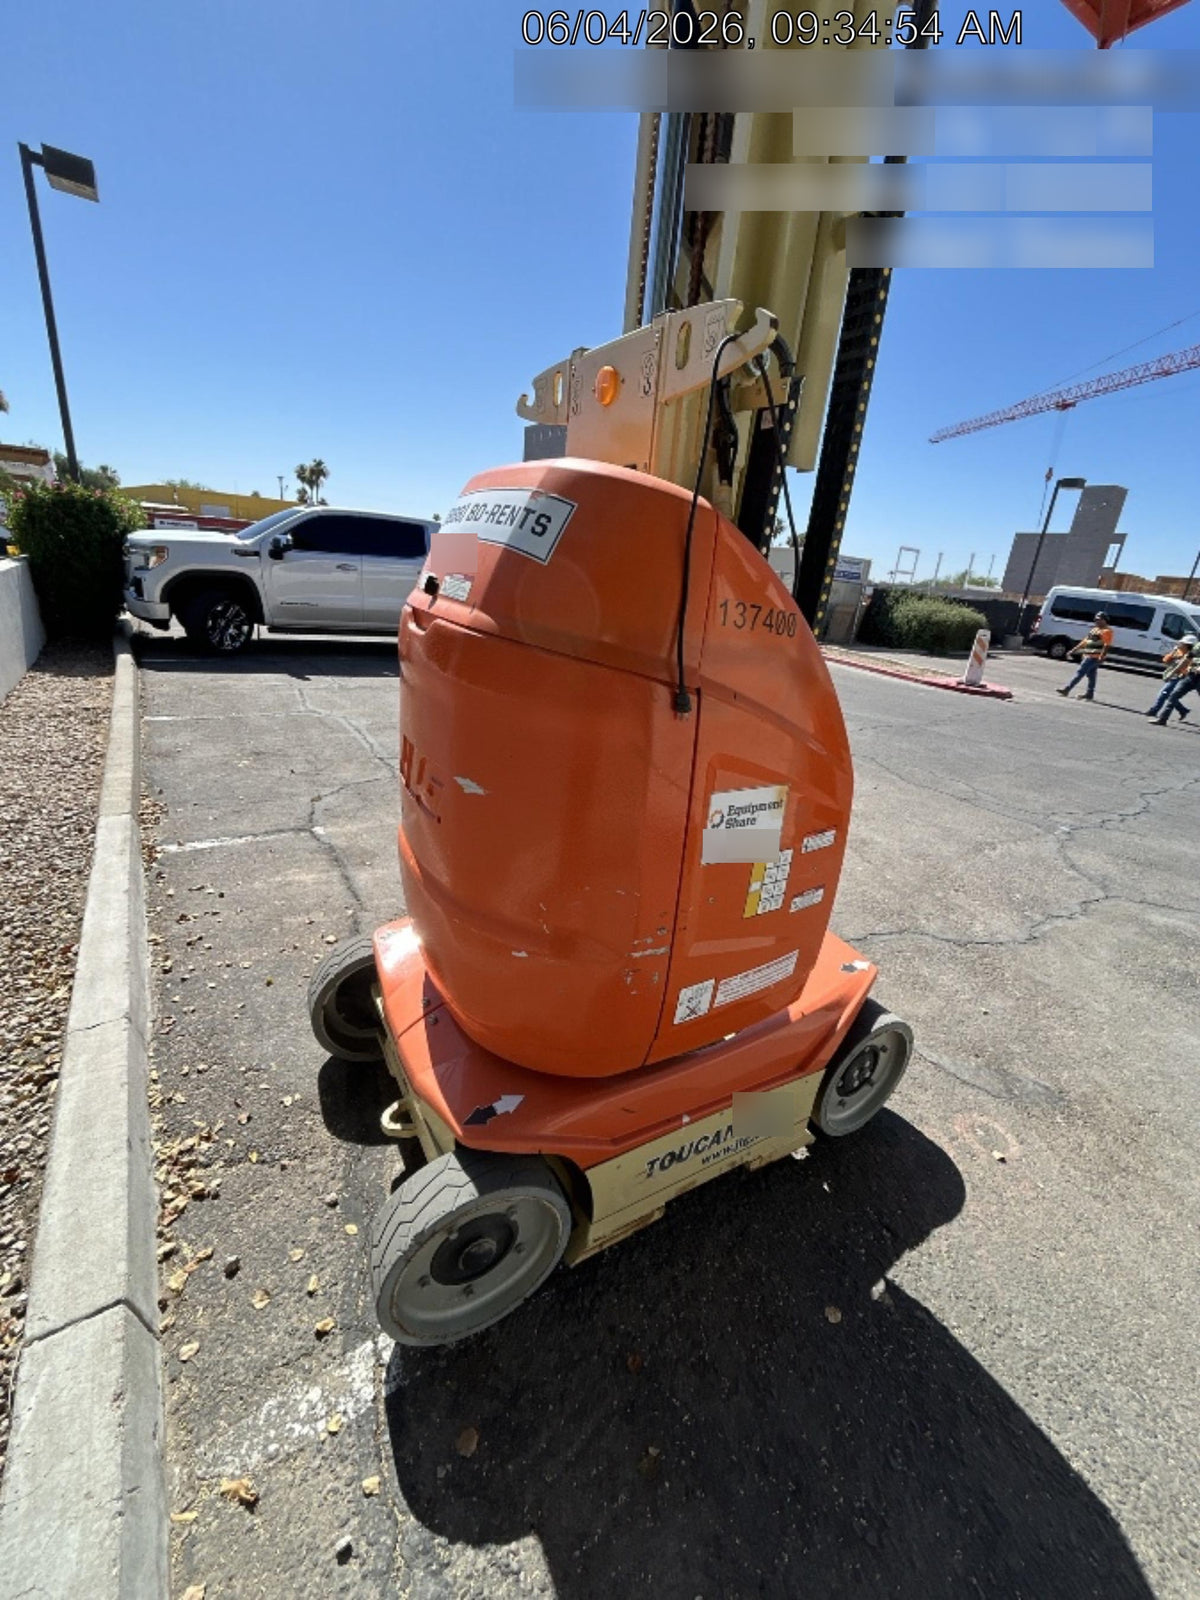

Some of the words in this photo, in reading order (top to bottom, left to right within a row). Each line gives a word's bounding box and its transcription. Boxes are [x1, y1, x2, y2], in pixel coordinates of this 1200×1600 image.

[719, 599, 797, 638] 137400
[727, 799, 783, 818] Equipment
[725, 816, 757, 829] Share
